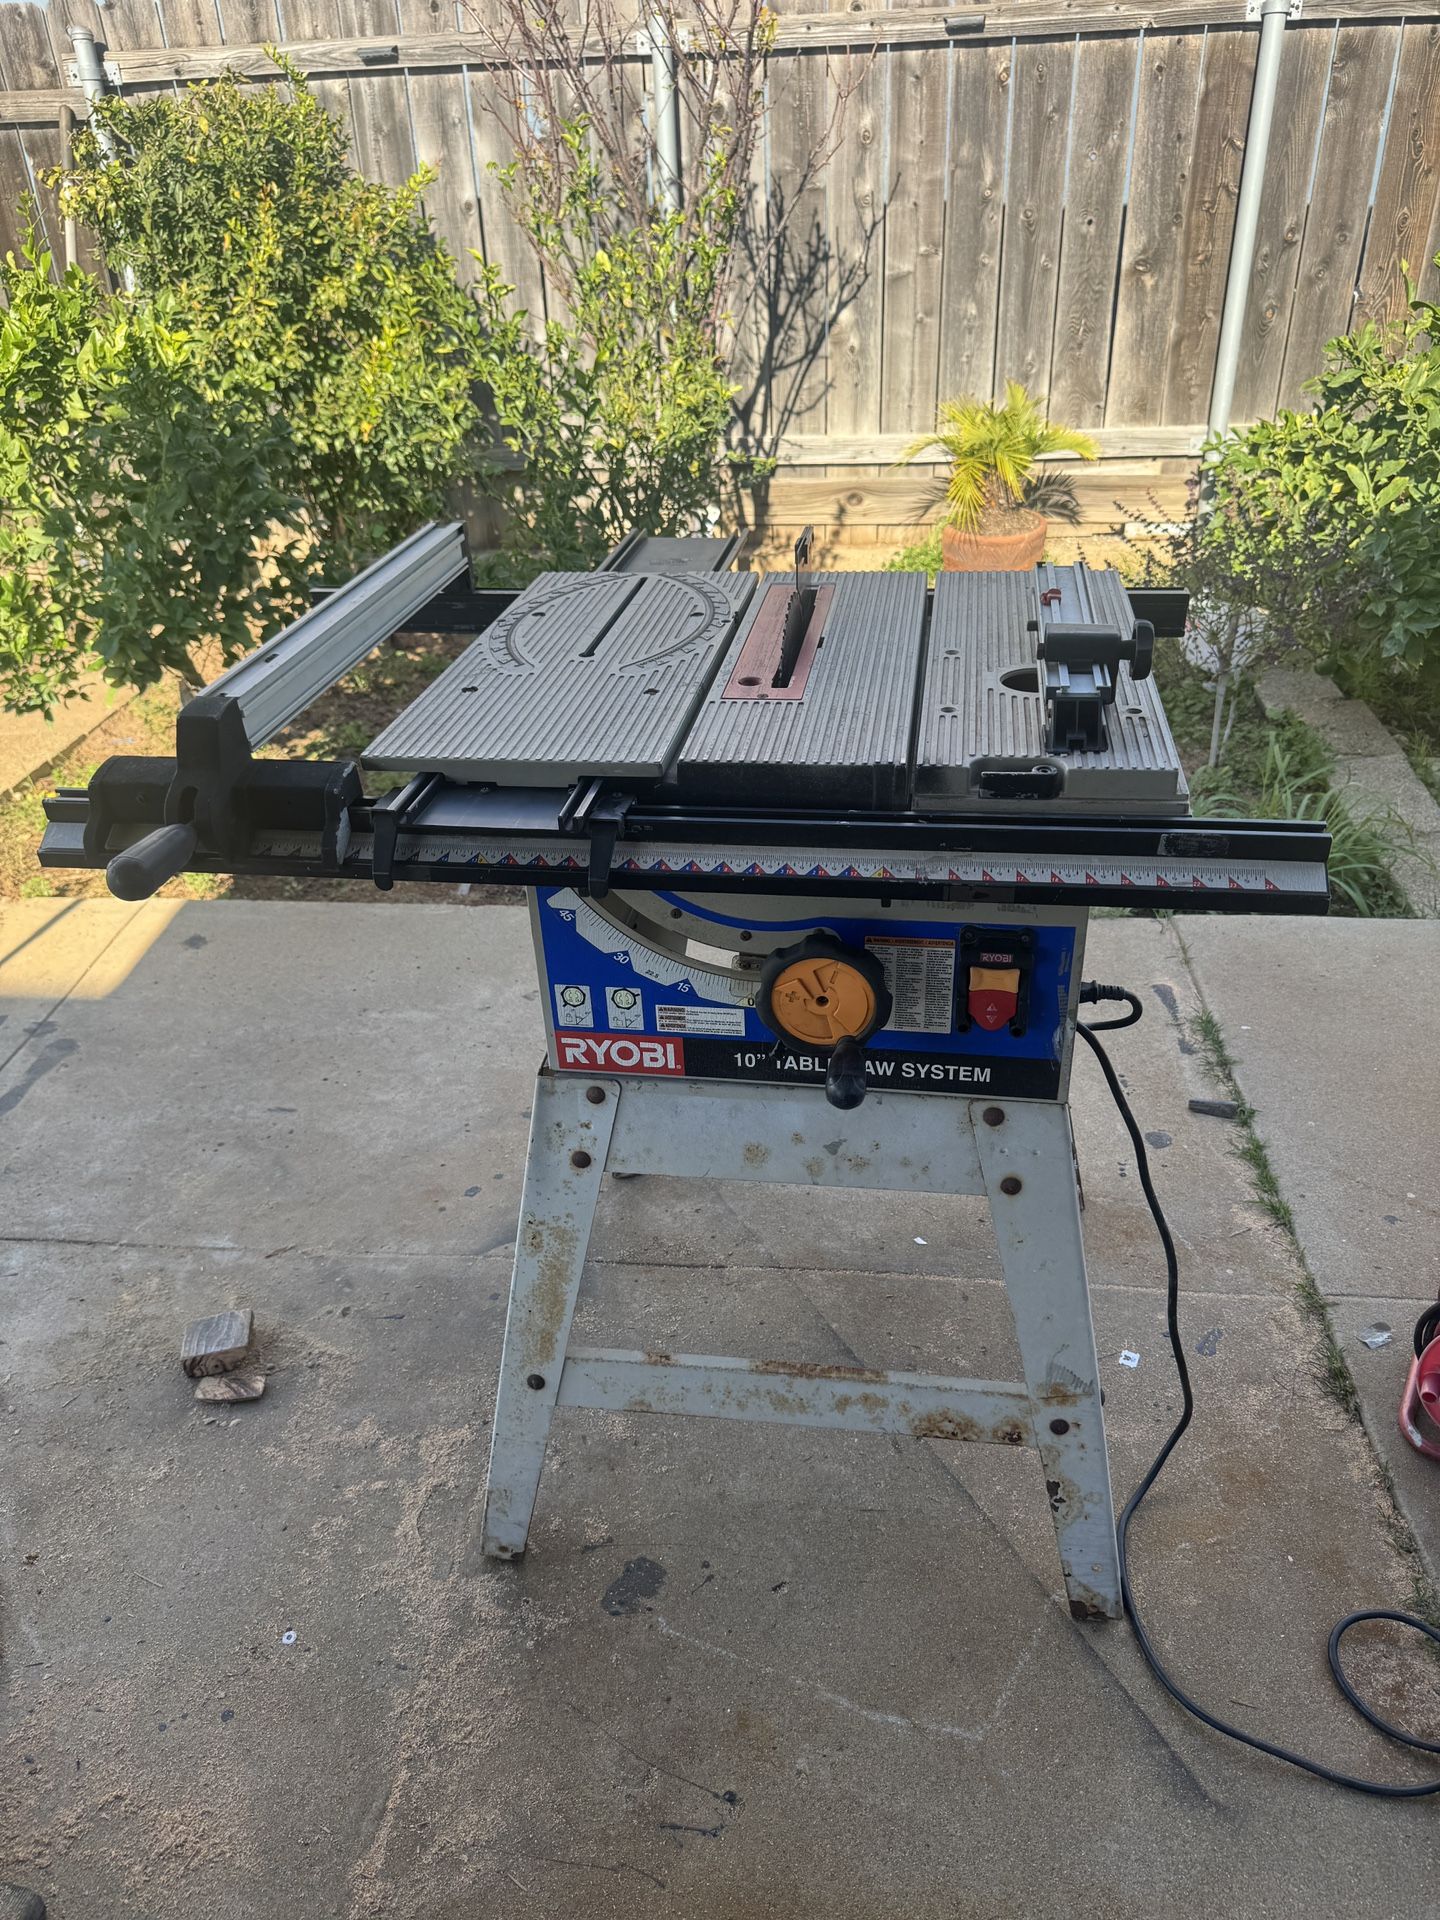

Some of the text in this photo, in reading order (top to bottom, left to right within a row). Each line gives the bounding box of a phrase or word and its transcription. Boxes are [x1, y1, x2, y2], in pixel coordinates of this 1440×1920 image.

[559, 910, 575, 922] 45
[613, 952, 630, 964] 30
[982, 953, 1012, 963] RYOBI
[677, 982, 691, 993] 15
[747, 998, 755, 1006] 0
[561, 1037, 676, 1069] RYOBI
[776, 1055, 832, 1073] ABL
[901, 1062, 991, 1083] SYSTEM
